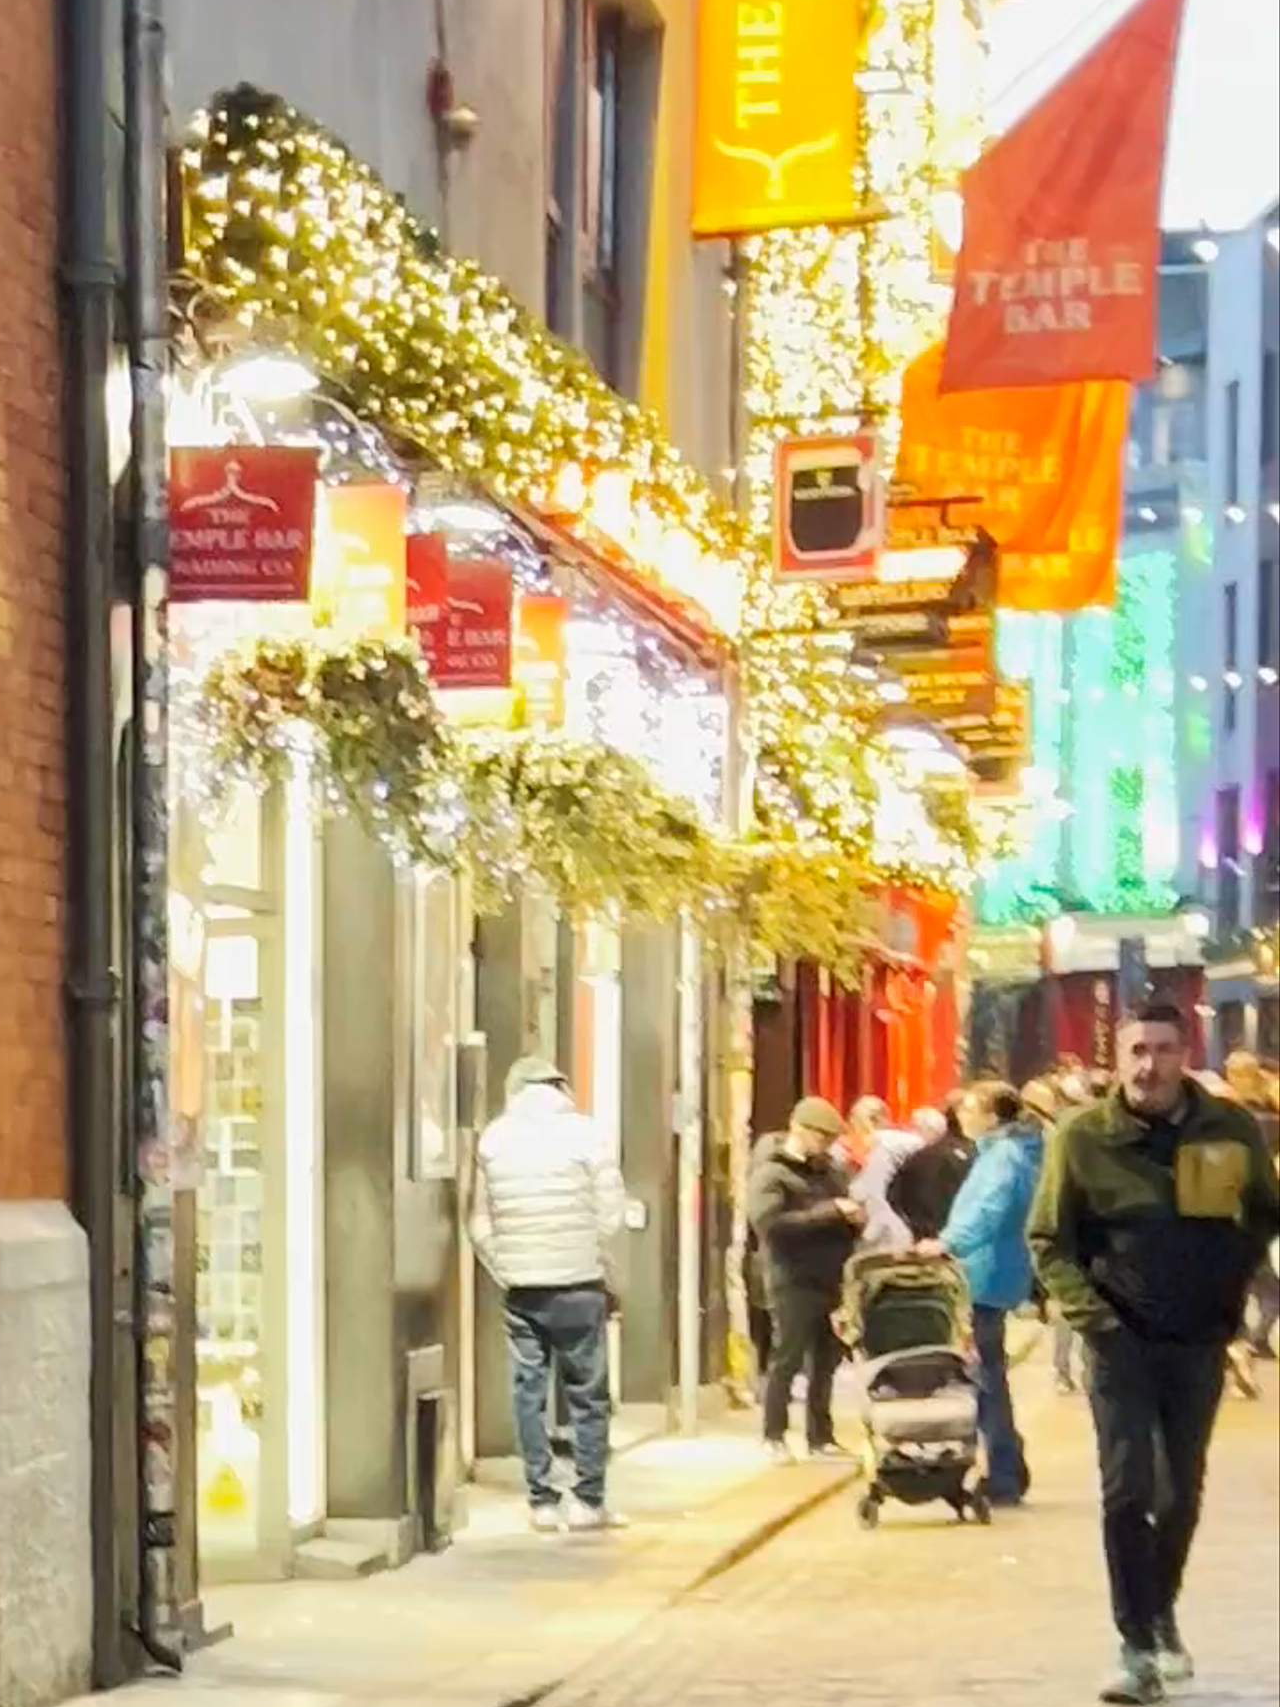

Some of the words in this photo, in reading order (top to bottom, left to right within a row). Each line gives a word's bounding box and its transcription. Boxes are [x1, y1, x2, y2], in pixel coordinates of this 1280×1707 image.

[735, 0, 785, 129] THE
[969, 262, 1144, 307] TEMPLE
[1004, 300, 1093, 334] BAR
